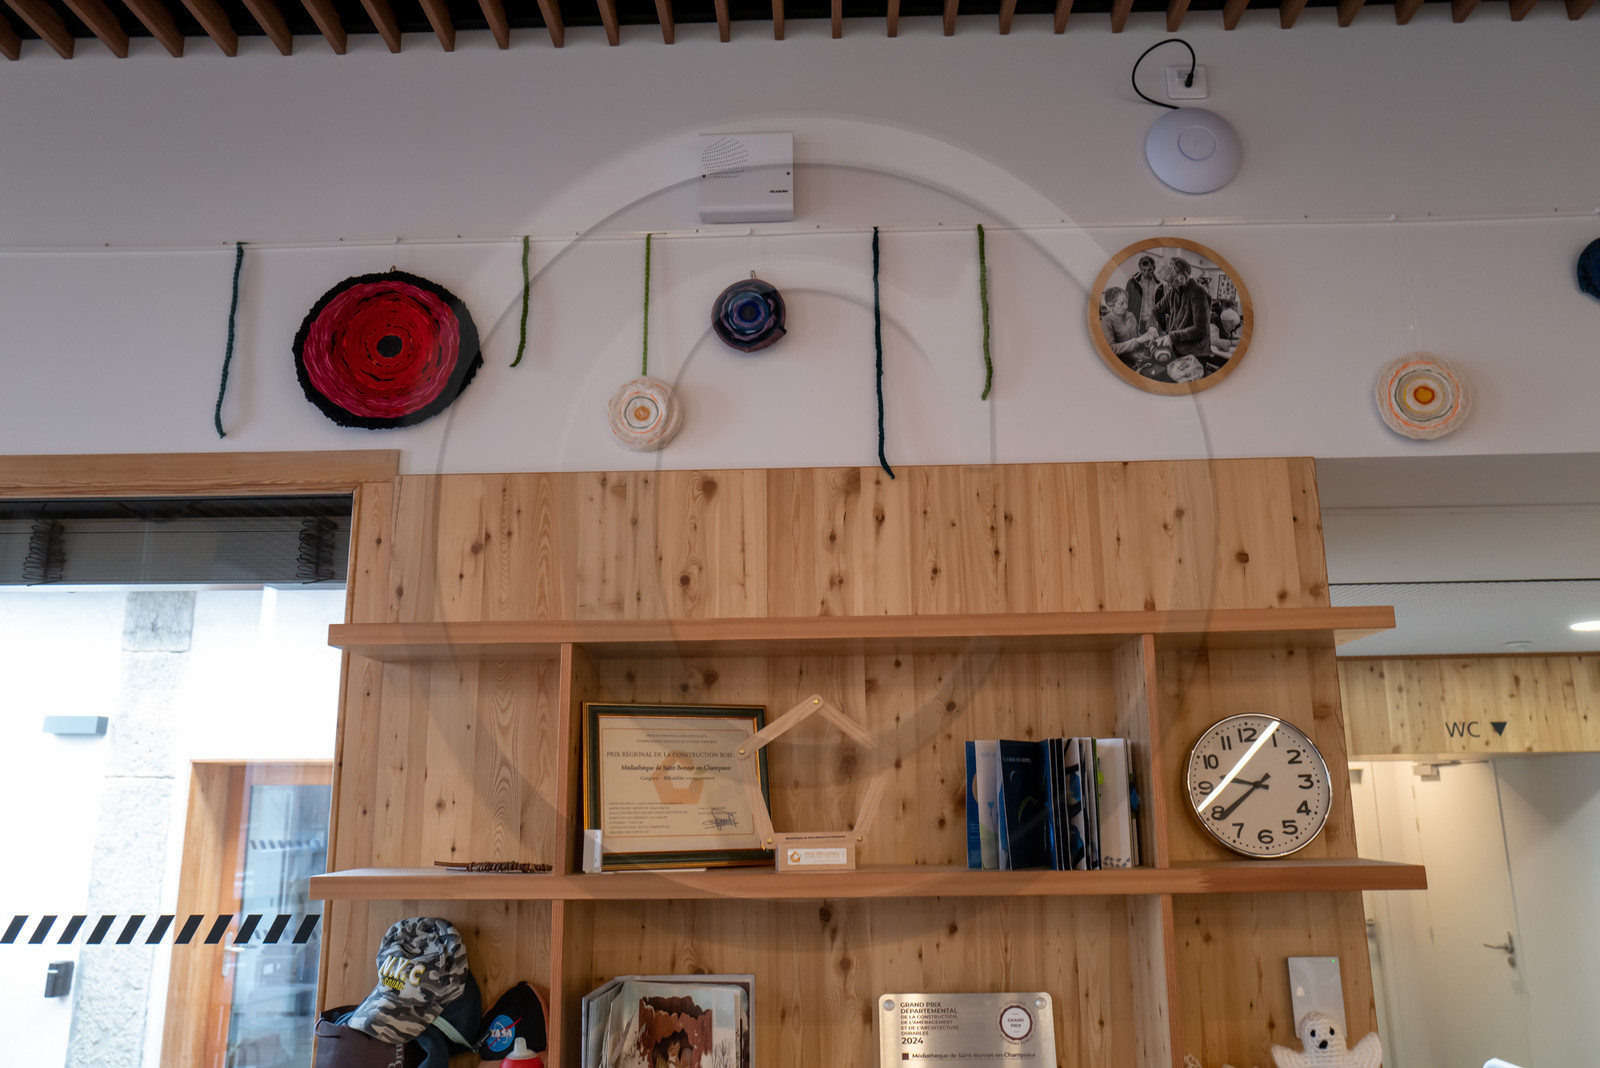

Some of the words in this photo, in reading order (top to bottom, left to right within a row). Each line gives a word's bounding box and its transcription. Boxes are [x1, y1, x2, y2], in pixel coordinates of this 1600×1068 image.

[1238, 727, 1258, 743] 12
[1445, 721, 1480, 738] WC
[1220, 735, 1232, 750] 11
[1271, 731, 1278, 748] 1
[621, 750, 653, 758] RÉGIONAL
[1286, 749, 1303, 765] 2
[1202, 754, 1220, 770] 10
[1198, 780, 1214, 795] 9
[1297, 774, 1314, 789] 3
[1211, 805, 1225, 820] 8
[1296, 800, 1312, 816] 4
[1232, 823, 1245, 838] 7
[1282, 820, 1298, 835] 5
[1257, 829, 1274, 844] 6
[901, 1037, 924, 1045] 2024
